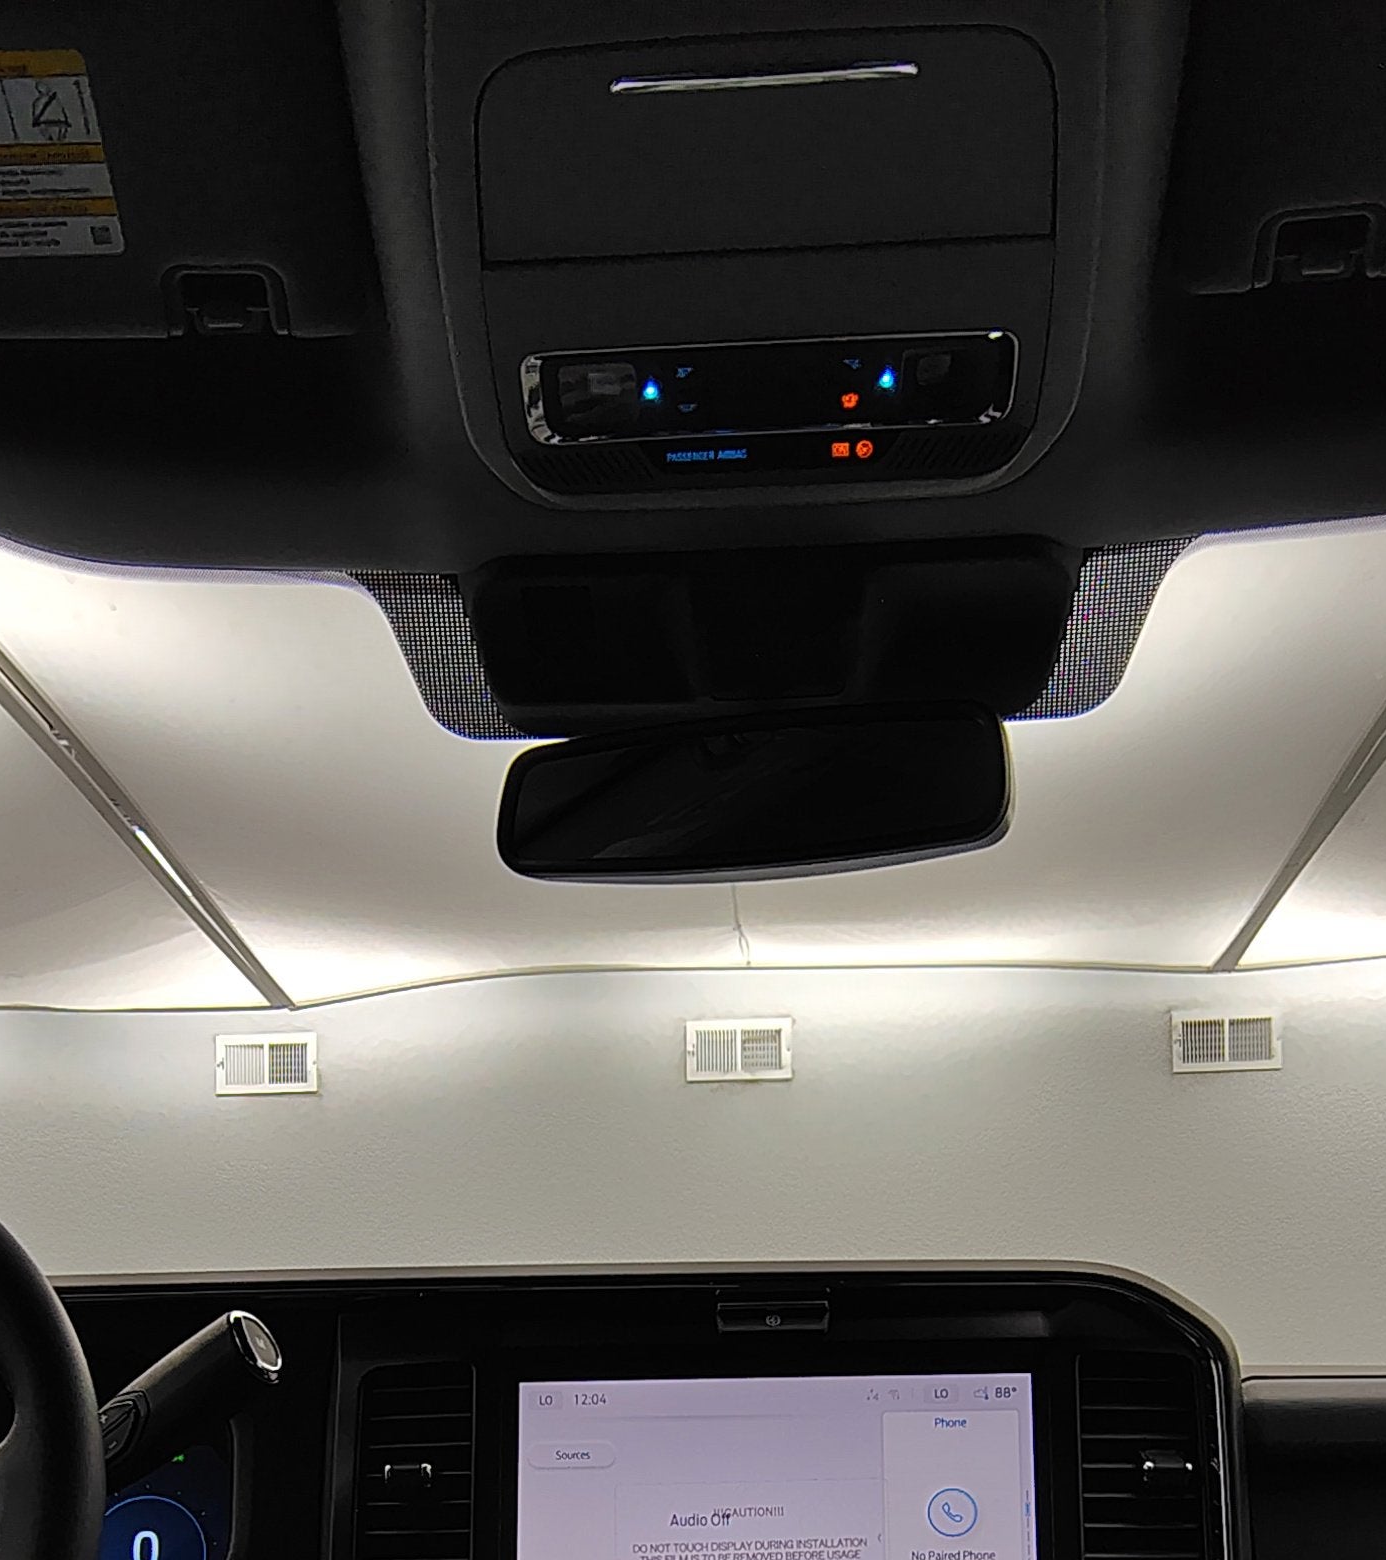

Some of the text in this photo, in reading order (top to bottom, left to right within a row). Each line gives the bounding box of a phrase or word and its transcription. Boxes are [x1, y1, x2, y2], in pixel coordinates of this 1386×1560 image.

[934, 1388, 948, 1399] LO
[538, 1394, 607, 1406] LO 12:04
[934, 1418, 967, 1428] Phone
[555, 1450, 591, 1461] Sources
[670, 1513, 731, 1527] Audio Off
[632, 1538, 868, 1554] DO NOT TOUCH DISPLAY DURING INSTALLATION
[785, 1550, 825, 1560] BEFORE
[826, 1549, 861, 1560] USAGE
[912, 1551, 996, 1560] No Paired Phone
